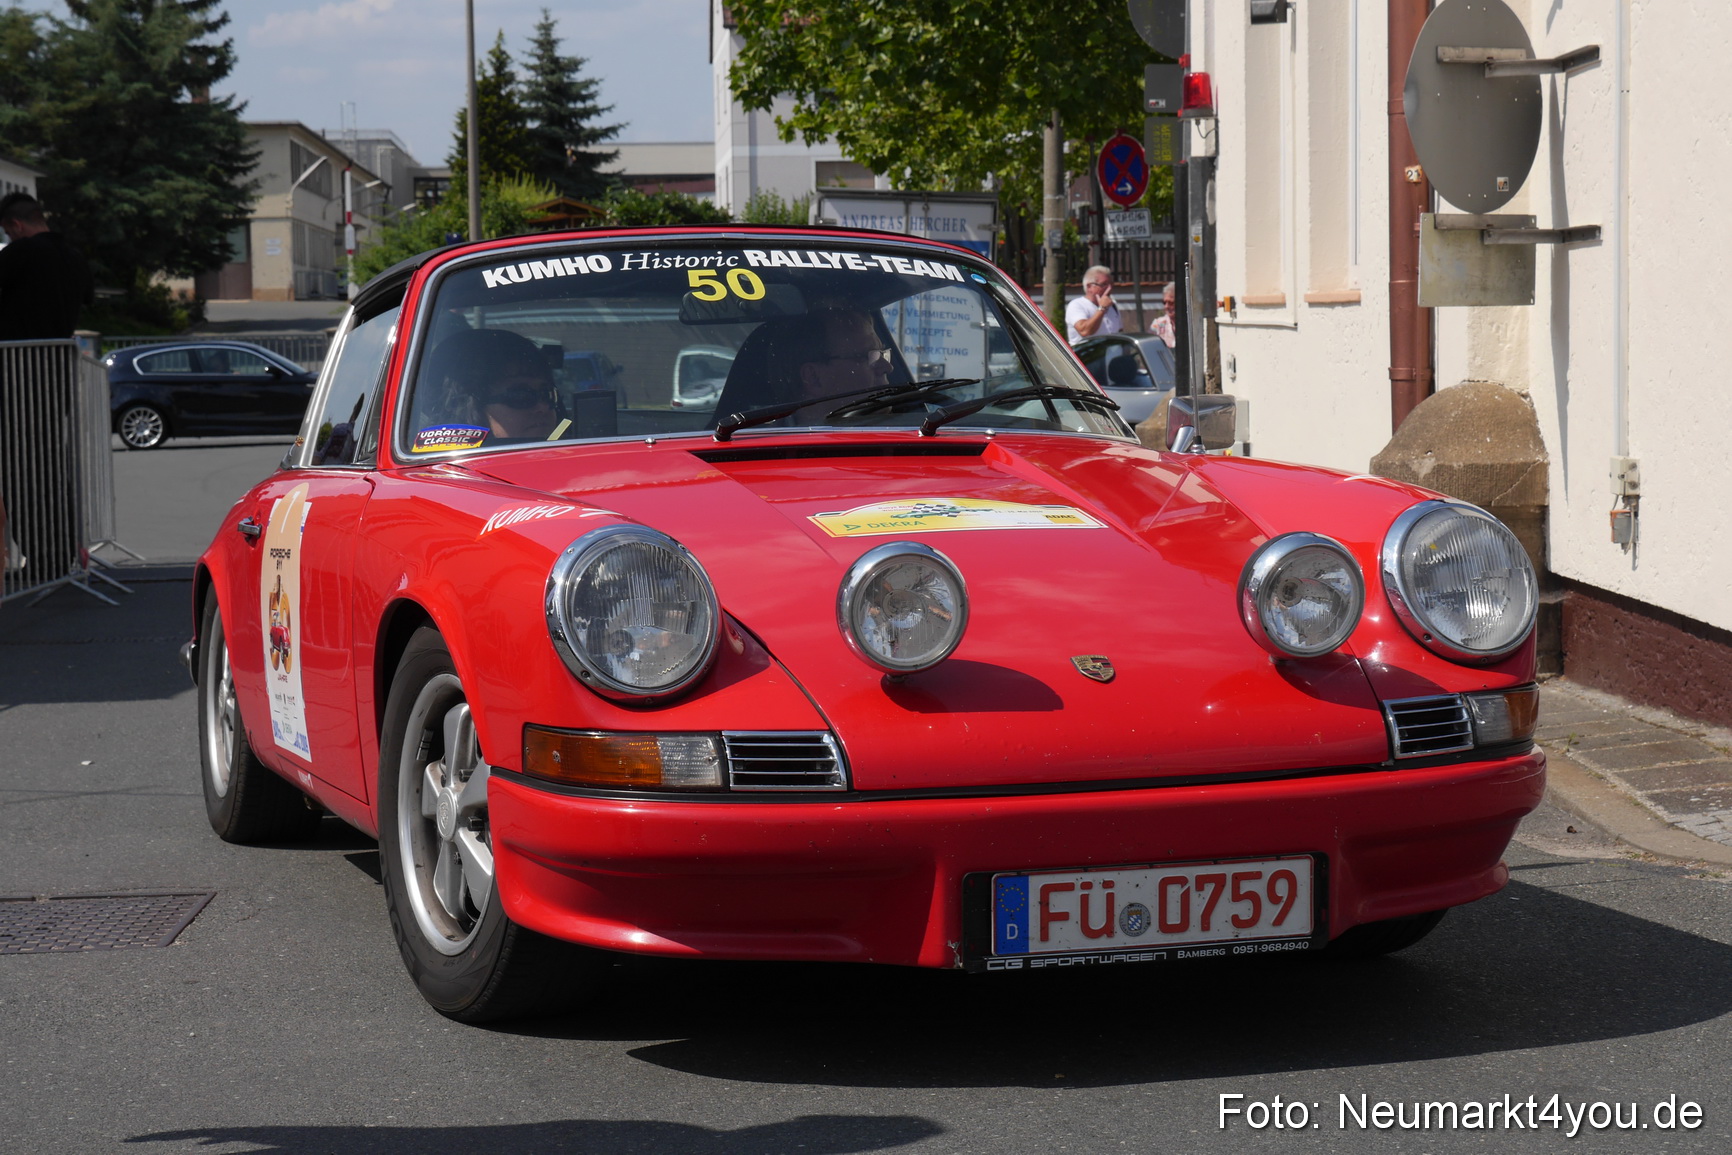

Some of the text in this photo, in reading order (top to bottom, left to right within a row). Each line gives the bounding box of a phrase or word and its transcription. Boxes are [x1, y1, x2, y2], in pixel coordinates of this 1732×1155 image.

[841, 214, 967, 233] ANDREAS HERCHER
[481, 249, 965, 289] KUMHO Historic RALLYE-TEAM
[687, 268, 766, 302] 50
[420, 429, 482, 438] VORALPEN
[424, 436, 471, 445] CLASSIC
[479, 505, 576, 536] KUMHO
[867, 520, 926, 530] DEKRA
[1006, 923, 1019, 940] D
[1038, 880, 1116, 942] FÜ
[1157, 868, 1298, 934] 0759
[986, 958, 1023, 971] CG
[1177, 948, 1226, 960] BAMBERG
[1232, 941, 1310, 955] 0951-9684940
